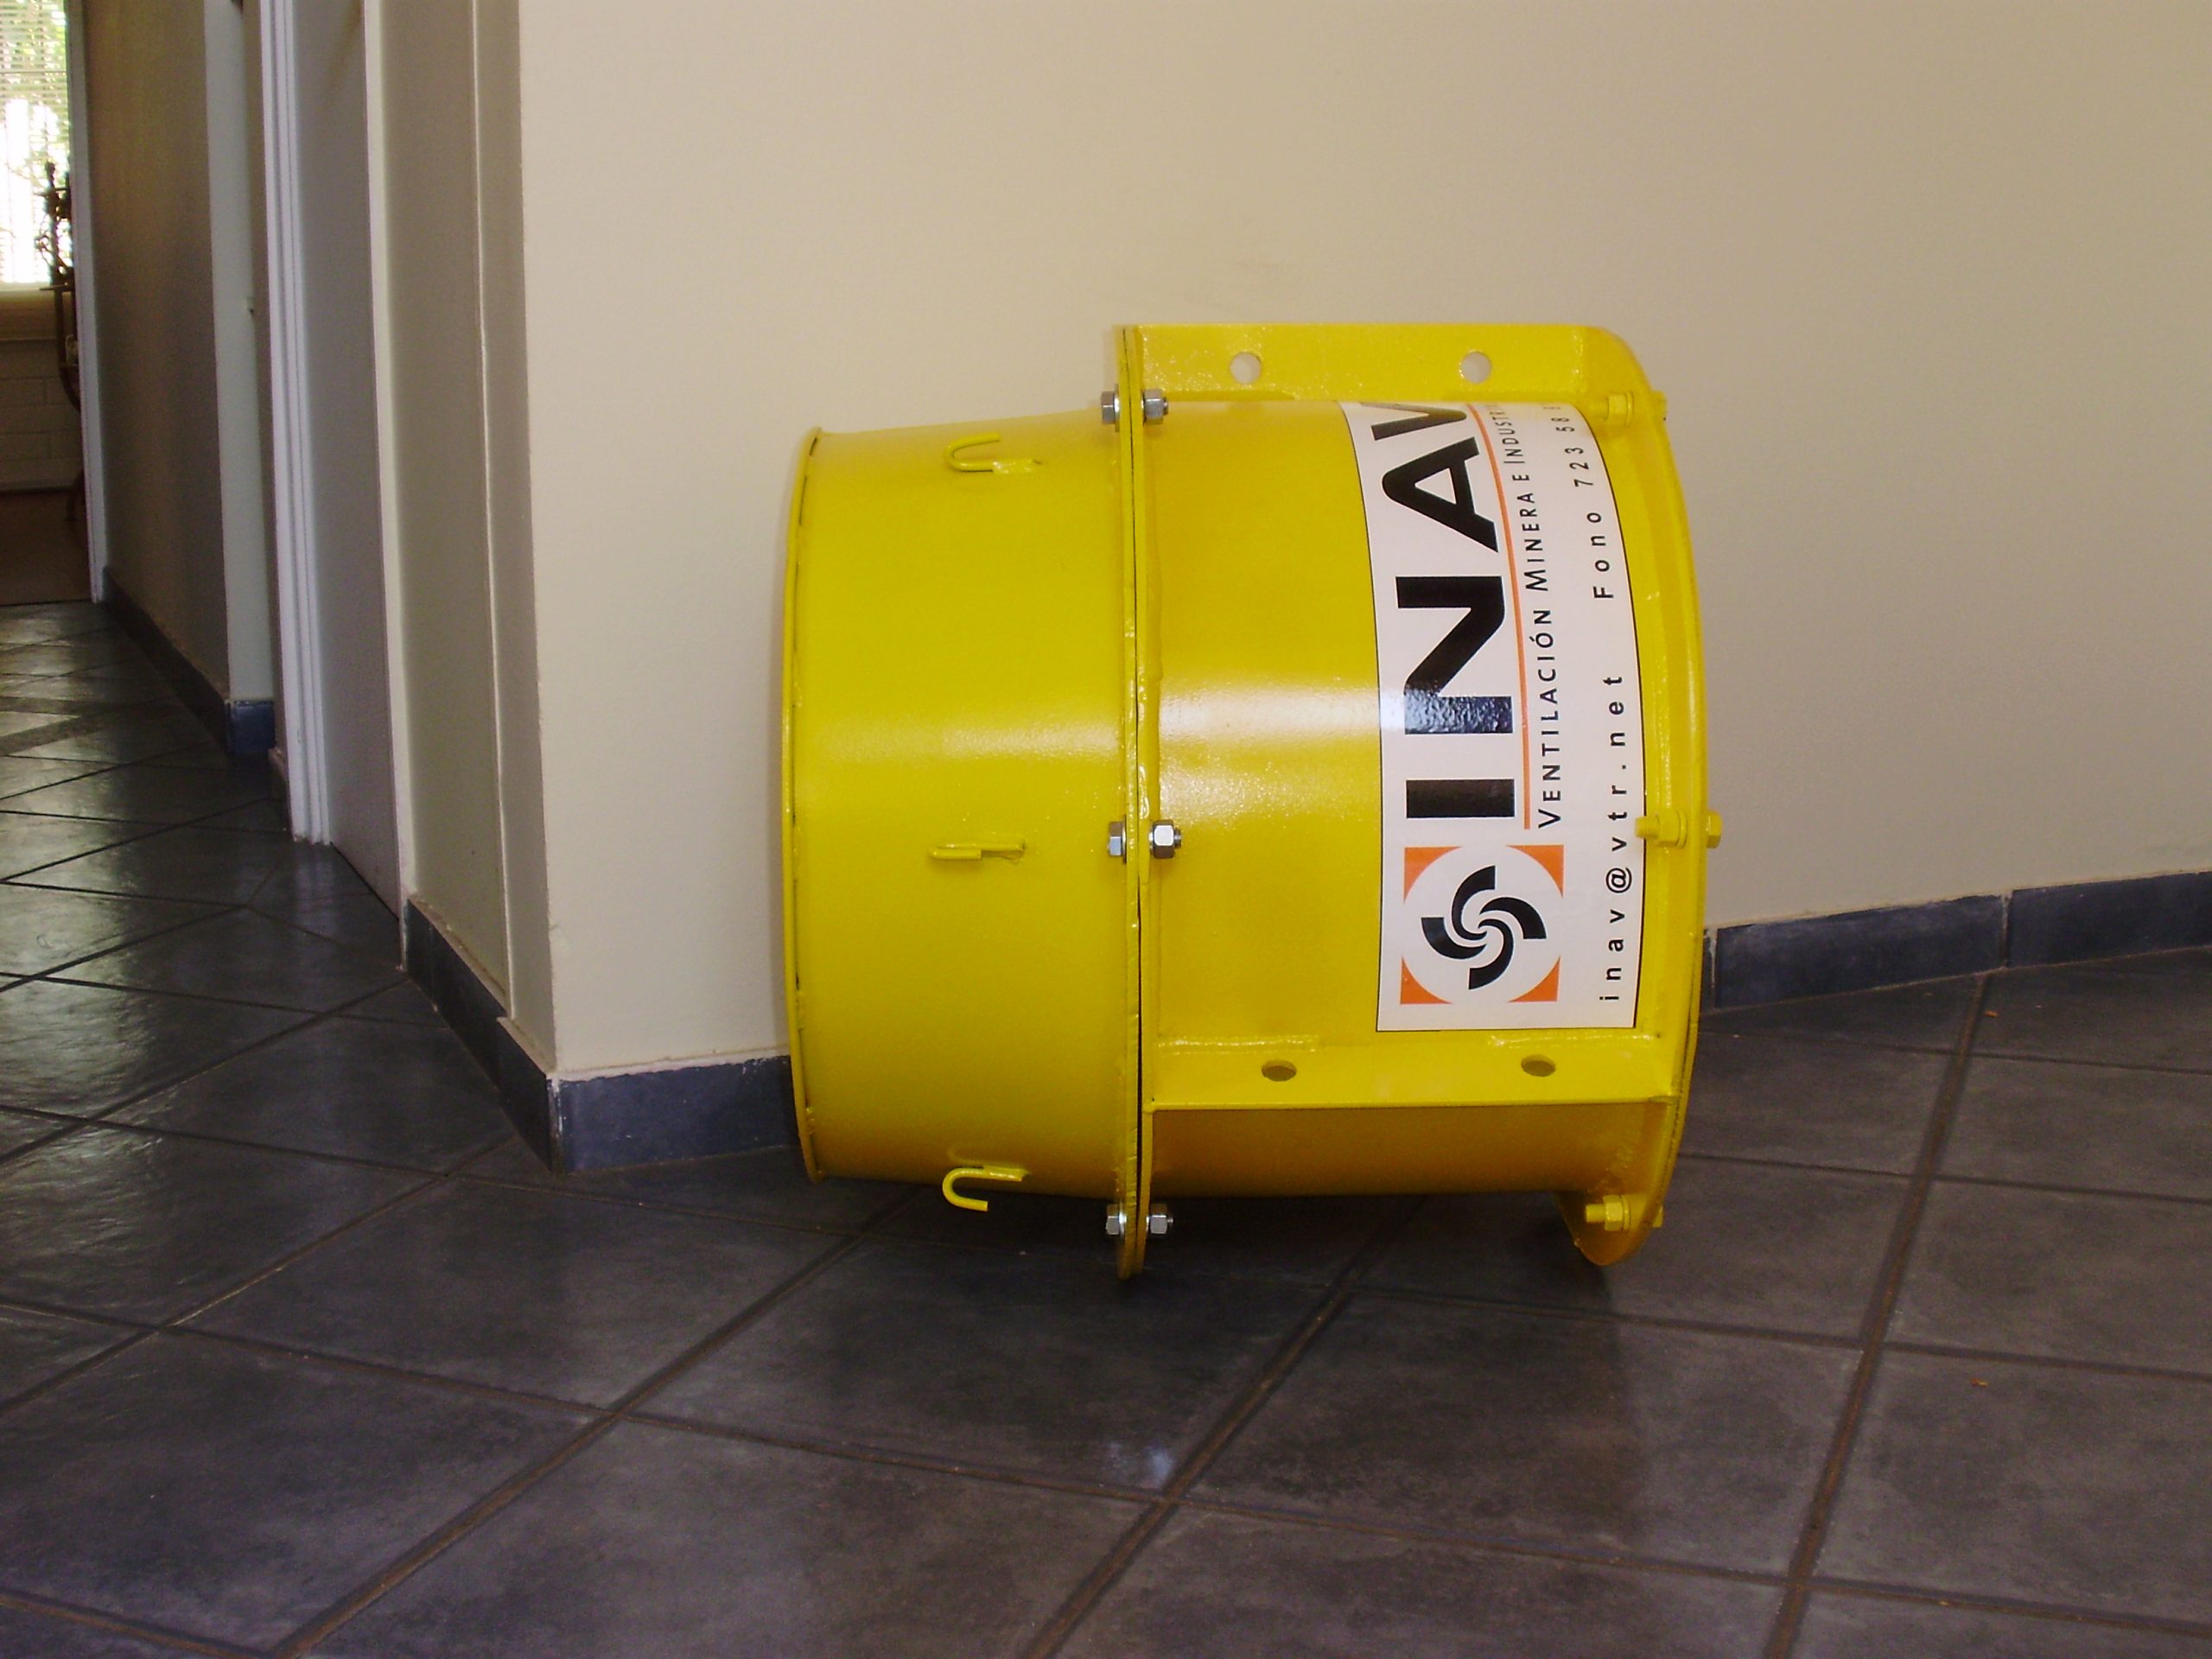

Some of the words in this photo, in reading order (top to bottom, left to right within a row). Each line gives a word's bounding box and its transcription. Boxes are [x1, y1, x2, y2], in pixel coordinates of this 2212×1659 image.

[1564, 447, 1594, 487] 723
[1516, 493, 1548, 592] MINERA
[1586, 512, 1614, 599] Fono
[1360, 401, 1516, 817] INAV
